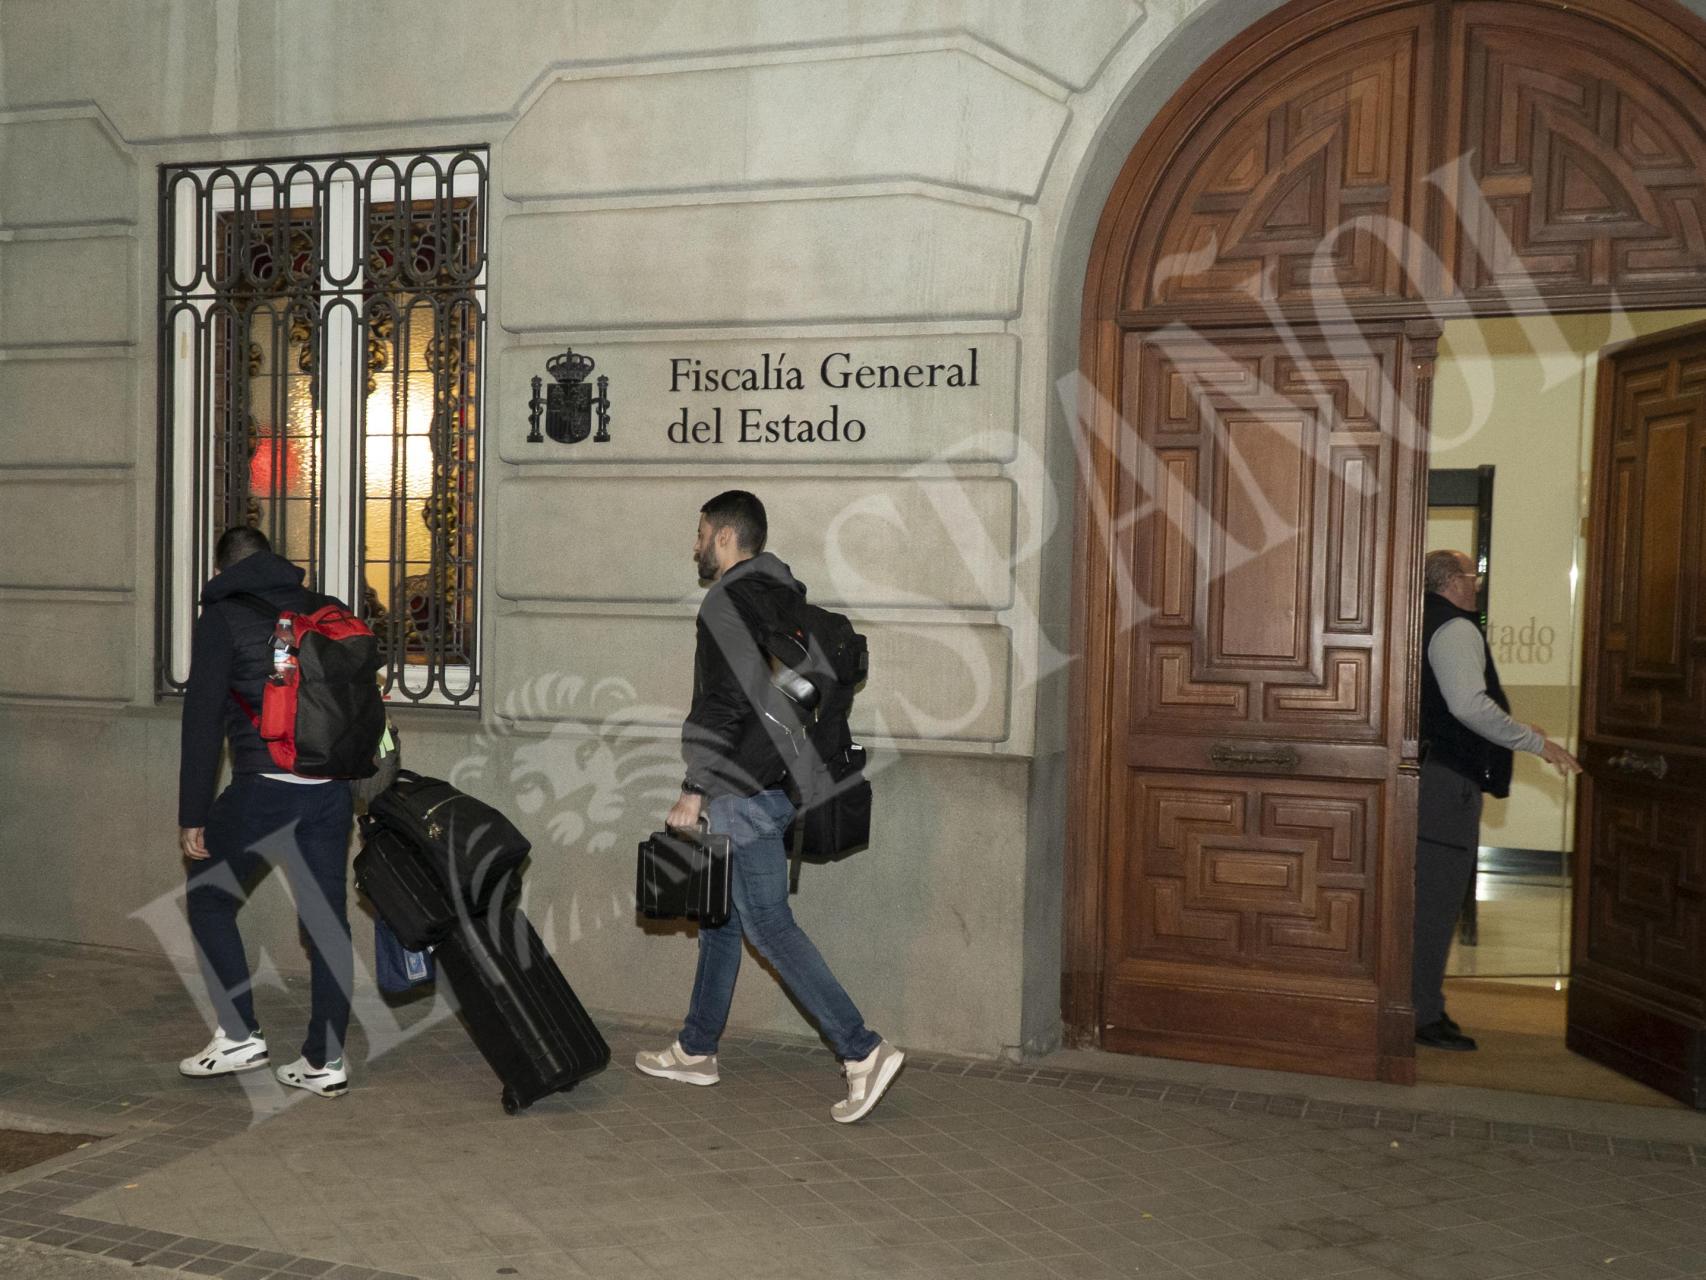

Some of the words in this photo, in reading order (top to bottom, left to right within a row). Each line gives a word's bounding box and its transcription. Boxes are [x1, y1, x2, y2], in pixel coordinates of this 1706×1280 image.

[669, 353, 805, 392] Fiscalía
[820, 348, 981, 389] General
[667, 407, 723, 444] del
[737, 405, 867, 443] Estado
[1488, 616, 1555, 646] tado
